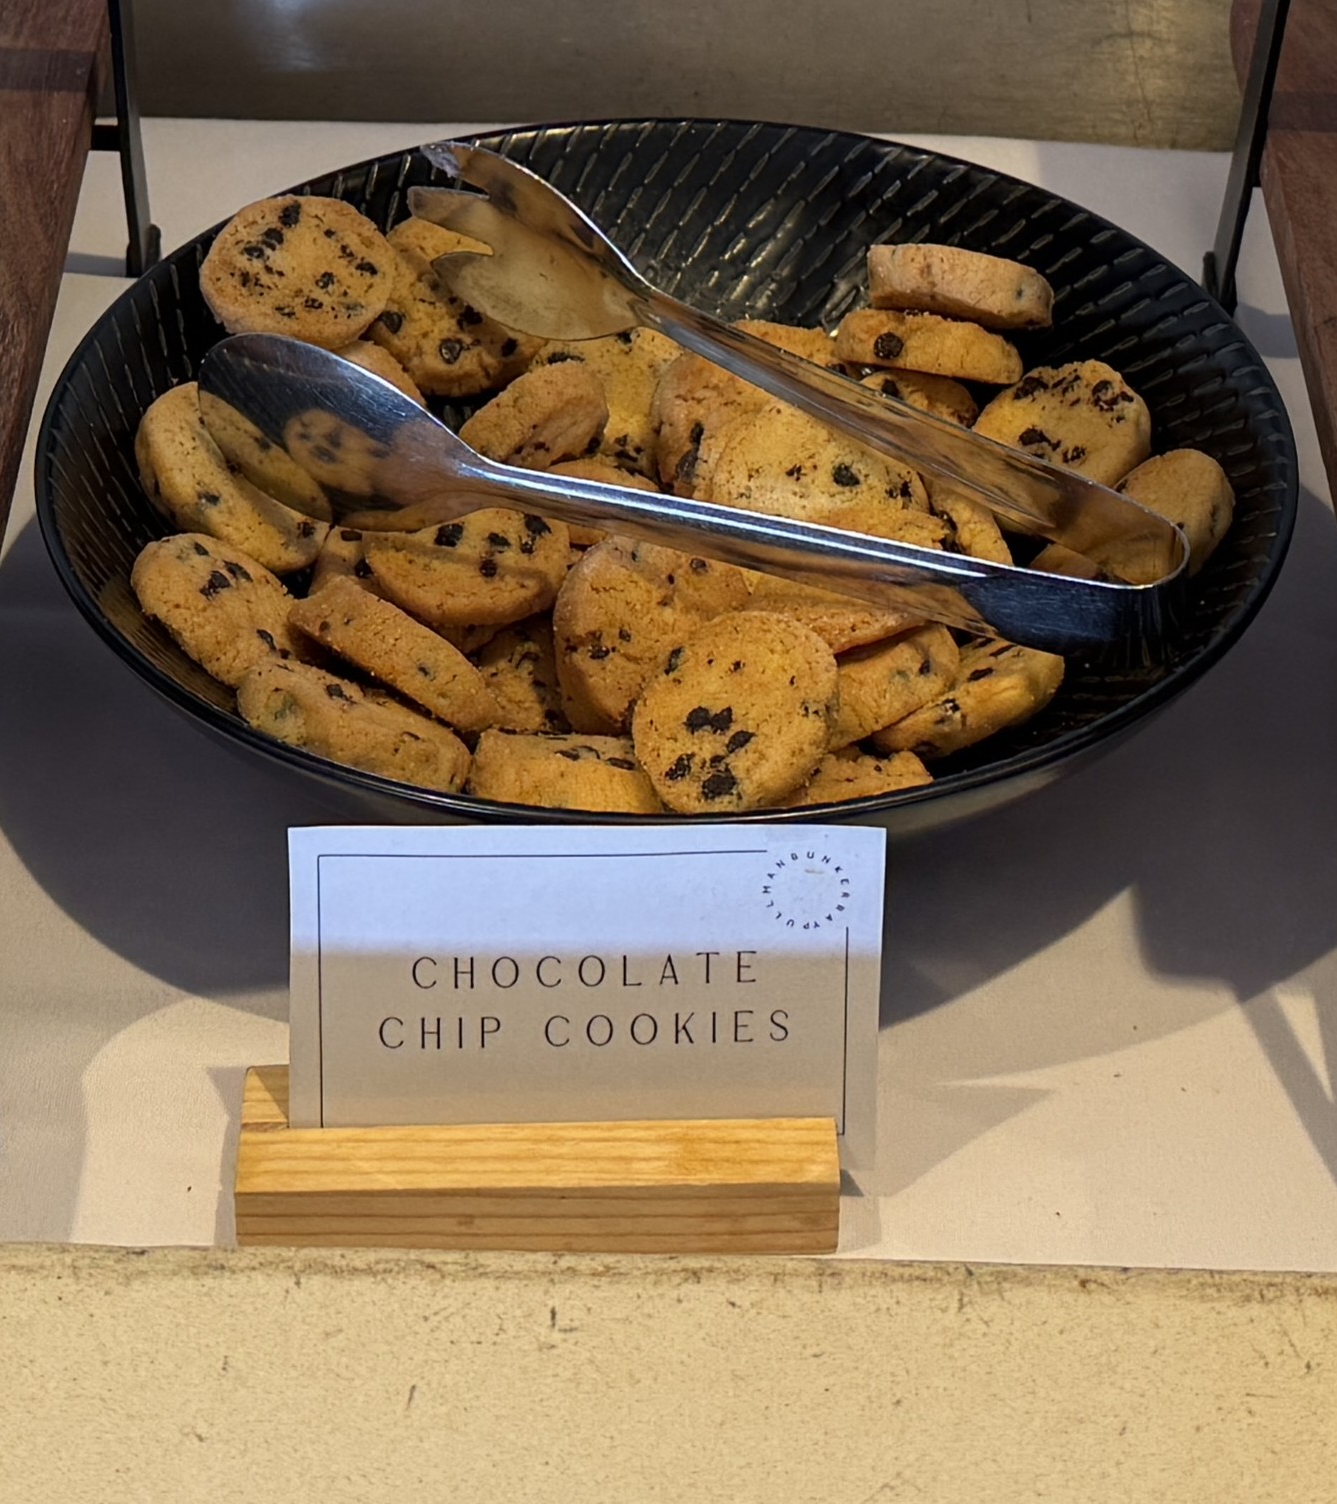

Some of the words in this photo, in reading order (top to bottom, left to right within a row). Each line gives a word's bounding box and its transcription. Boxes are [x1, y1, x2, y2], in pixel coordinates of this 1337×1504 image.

[410, 949, 759, 991] CHOCOLATE
[377, 1014, 503, 1051] CHIP
[542, 1008, 790, 1049] COOKIES
